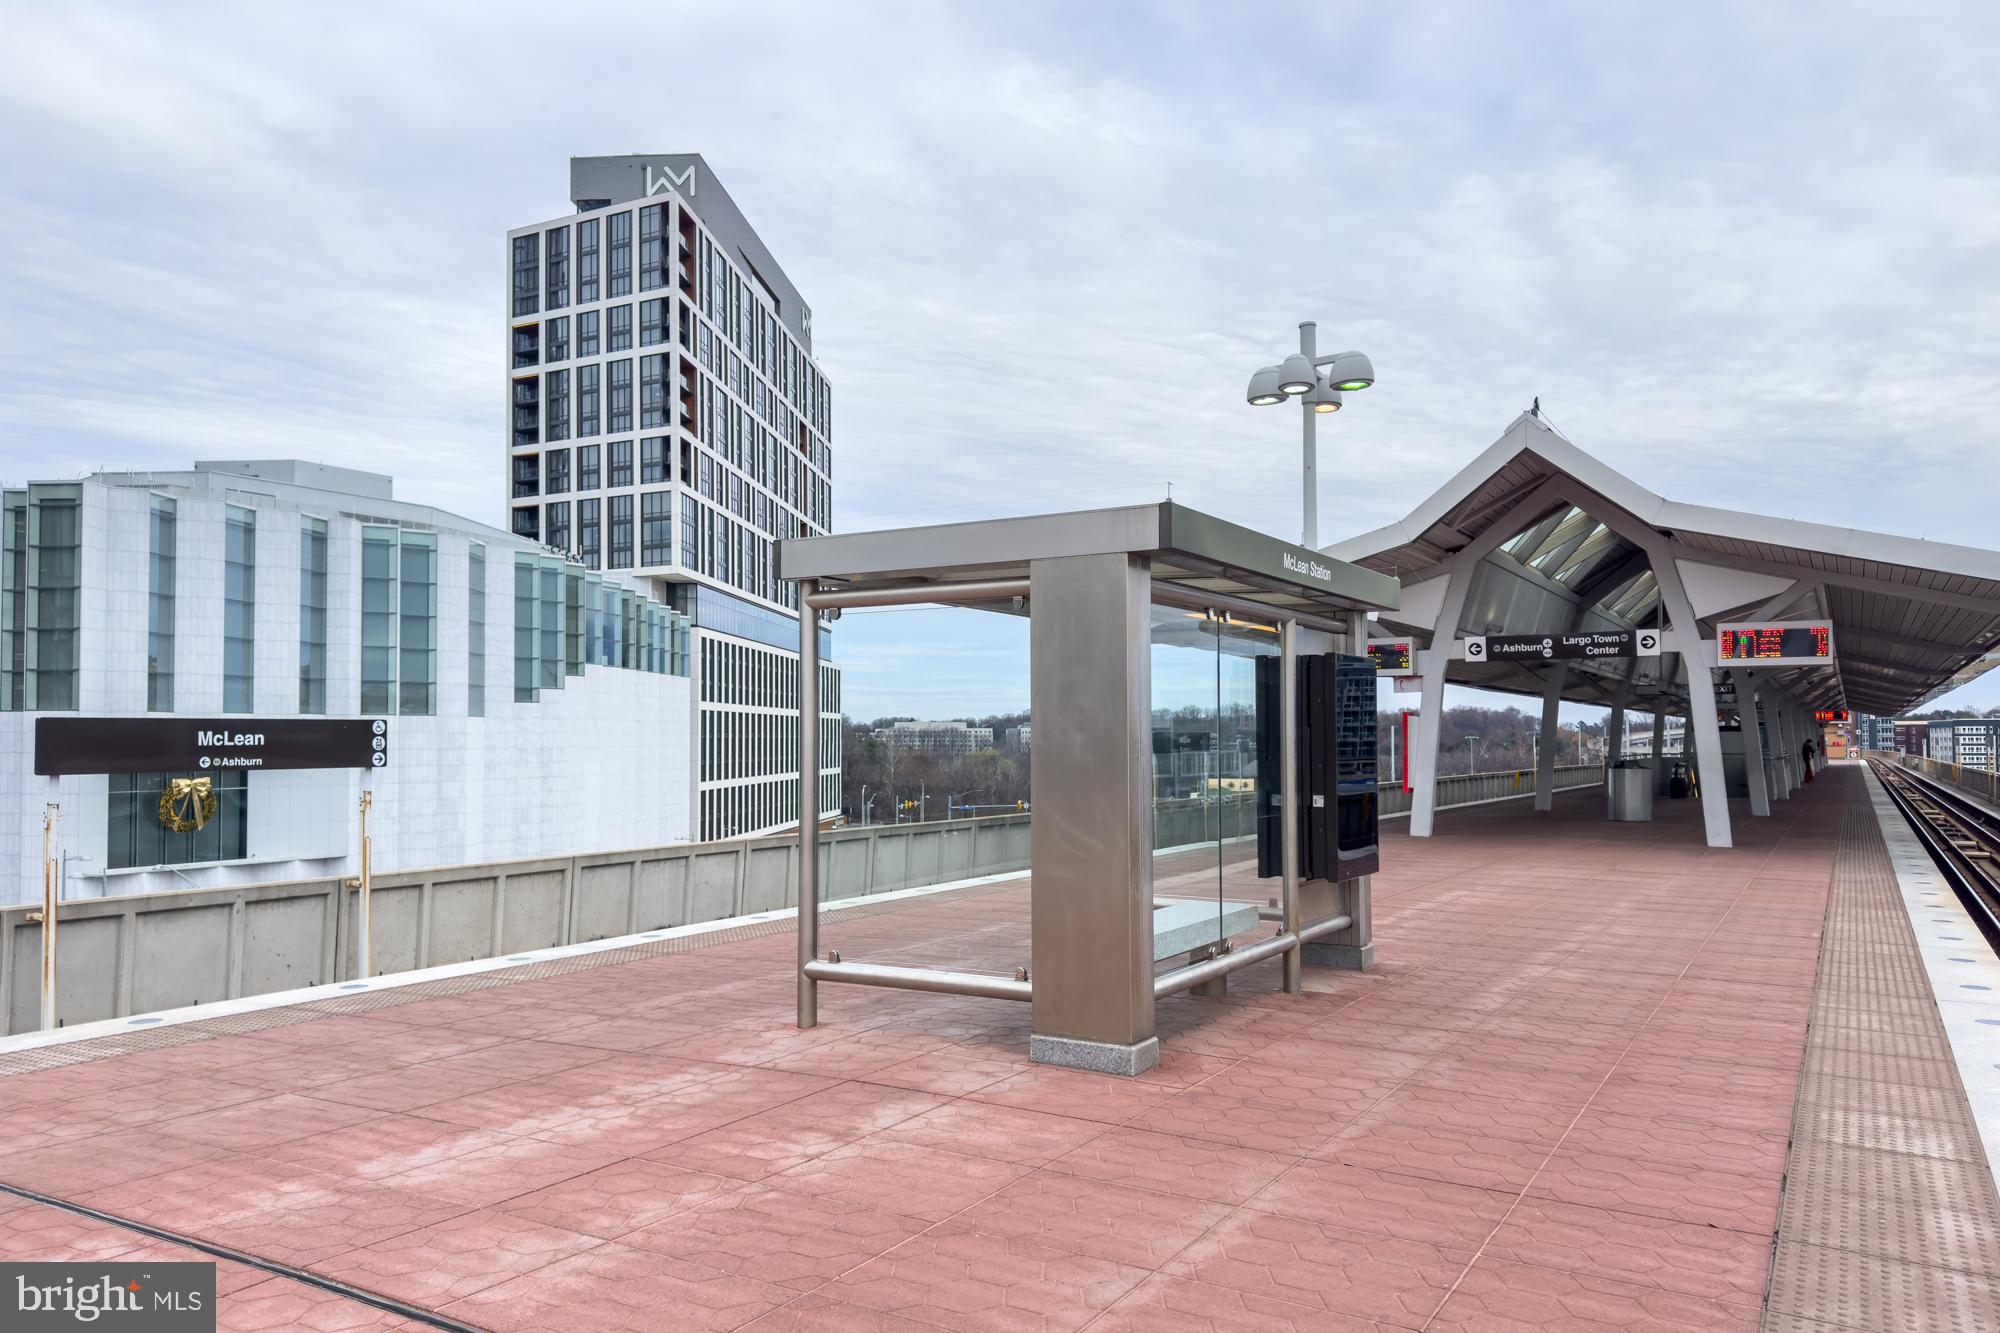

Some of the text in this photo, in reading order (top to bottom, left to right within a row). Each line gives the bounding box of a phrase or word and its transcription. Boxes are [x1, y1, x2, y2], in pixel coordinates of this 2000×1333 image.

[1283, 552, 1332, 582] McLean Station
[1562, 636, 1592, 646] Largo
[1593, 634, 1620, 643] Town
[1502, 643, 1544, 653] Ashburn
[1585, 646, 1620, 655] Center
[197, 730, 265, 746] McLean
[221, 756, 263, 767] Ashburn
